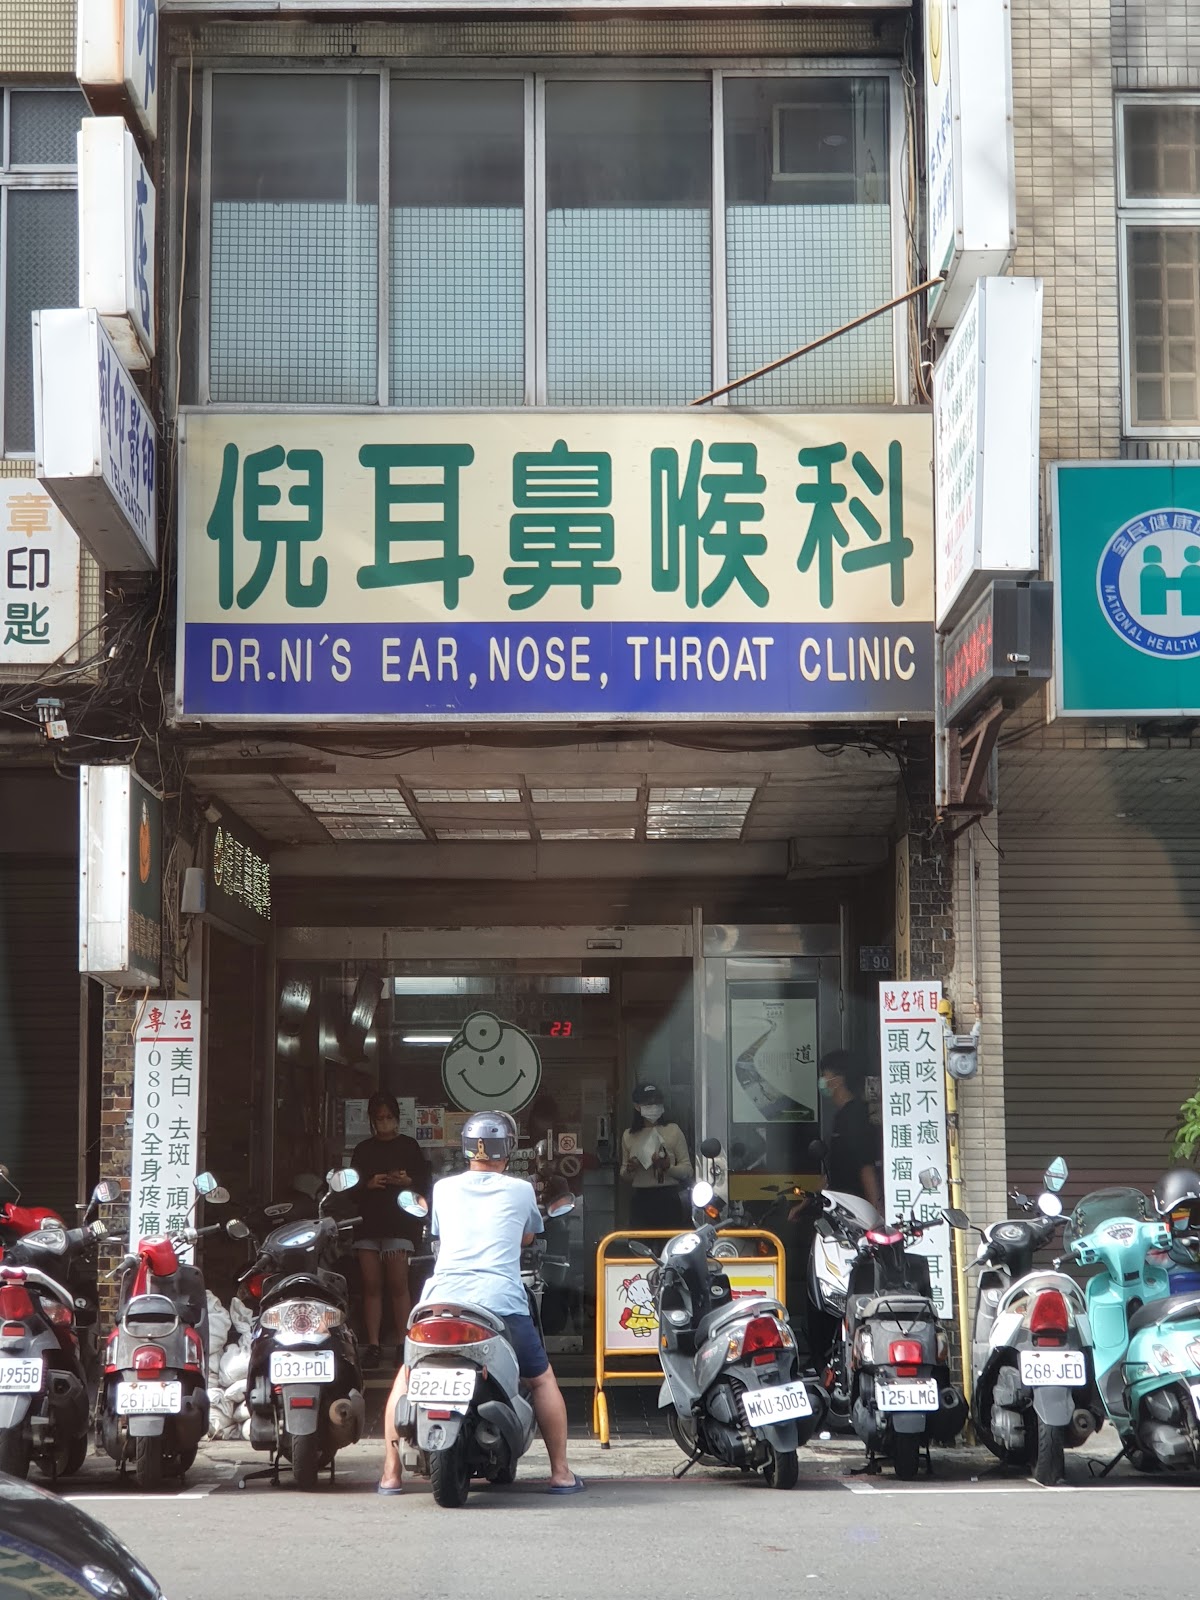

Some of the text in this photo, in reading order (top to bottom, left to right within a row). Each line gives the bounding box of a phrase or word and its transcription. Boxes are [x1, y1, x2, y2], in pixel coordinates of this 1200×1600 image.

[6, 493, 51, 538] 章
[206, 439, 914, 611] 倪耳鼻喉科
[1111, 512, 1200, 558] 全民健康
[7, 546, 50, 591] 印
[3, 601, 51, 646] 匙
[1104, 584, 1198, 652] NATIONAL HEALTH
[626, 637, 775, 682] THROAT
[799, 637, 917, 683] CLINIC
[872, 955, 890, 969] 90
[551, 1022, 572, 1036] 23
[165, 1047, 193, 1264] 美白、去斑、頑癬
[887, 1028, 914, 1238] 頭頸部腫瘤早
